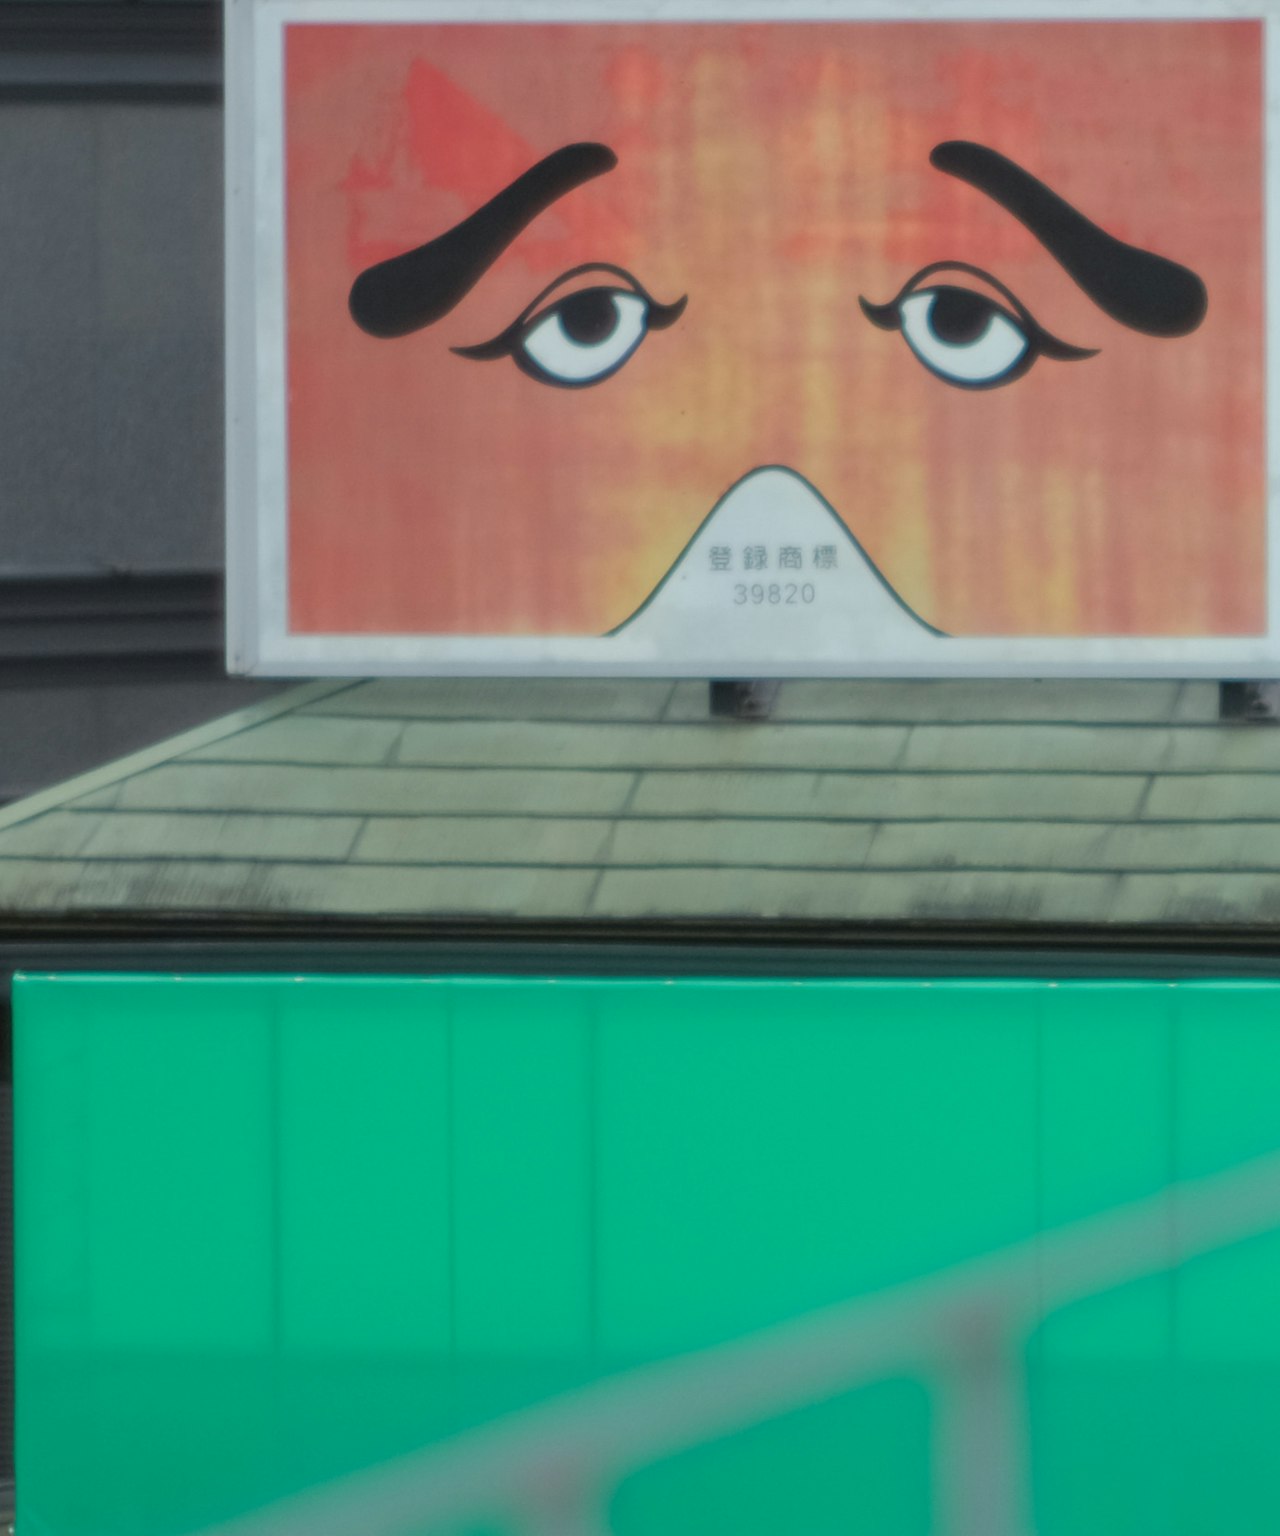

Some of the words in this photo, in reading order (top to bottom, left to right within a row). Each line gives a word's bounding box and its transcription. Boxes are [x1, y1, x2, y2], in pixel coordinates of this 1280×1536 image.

[708, 545, 839, 572] 登録商標
[733, 583, 816, 606] 39820
